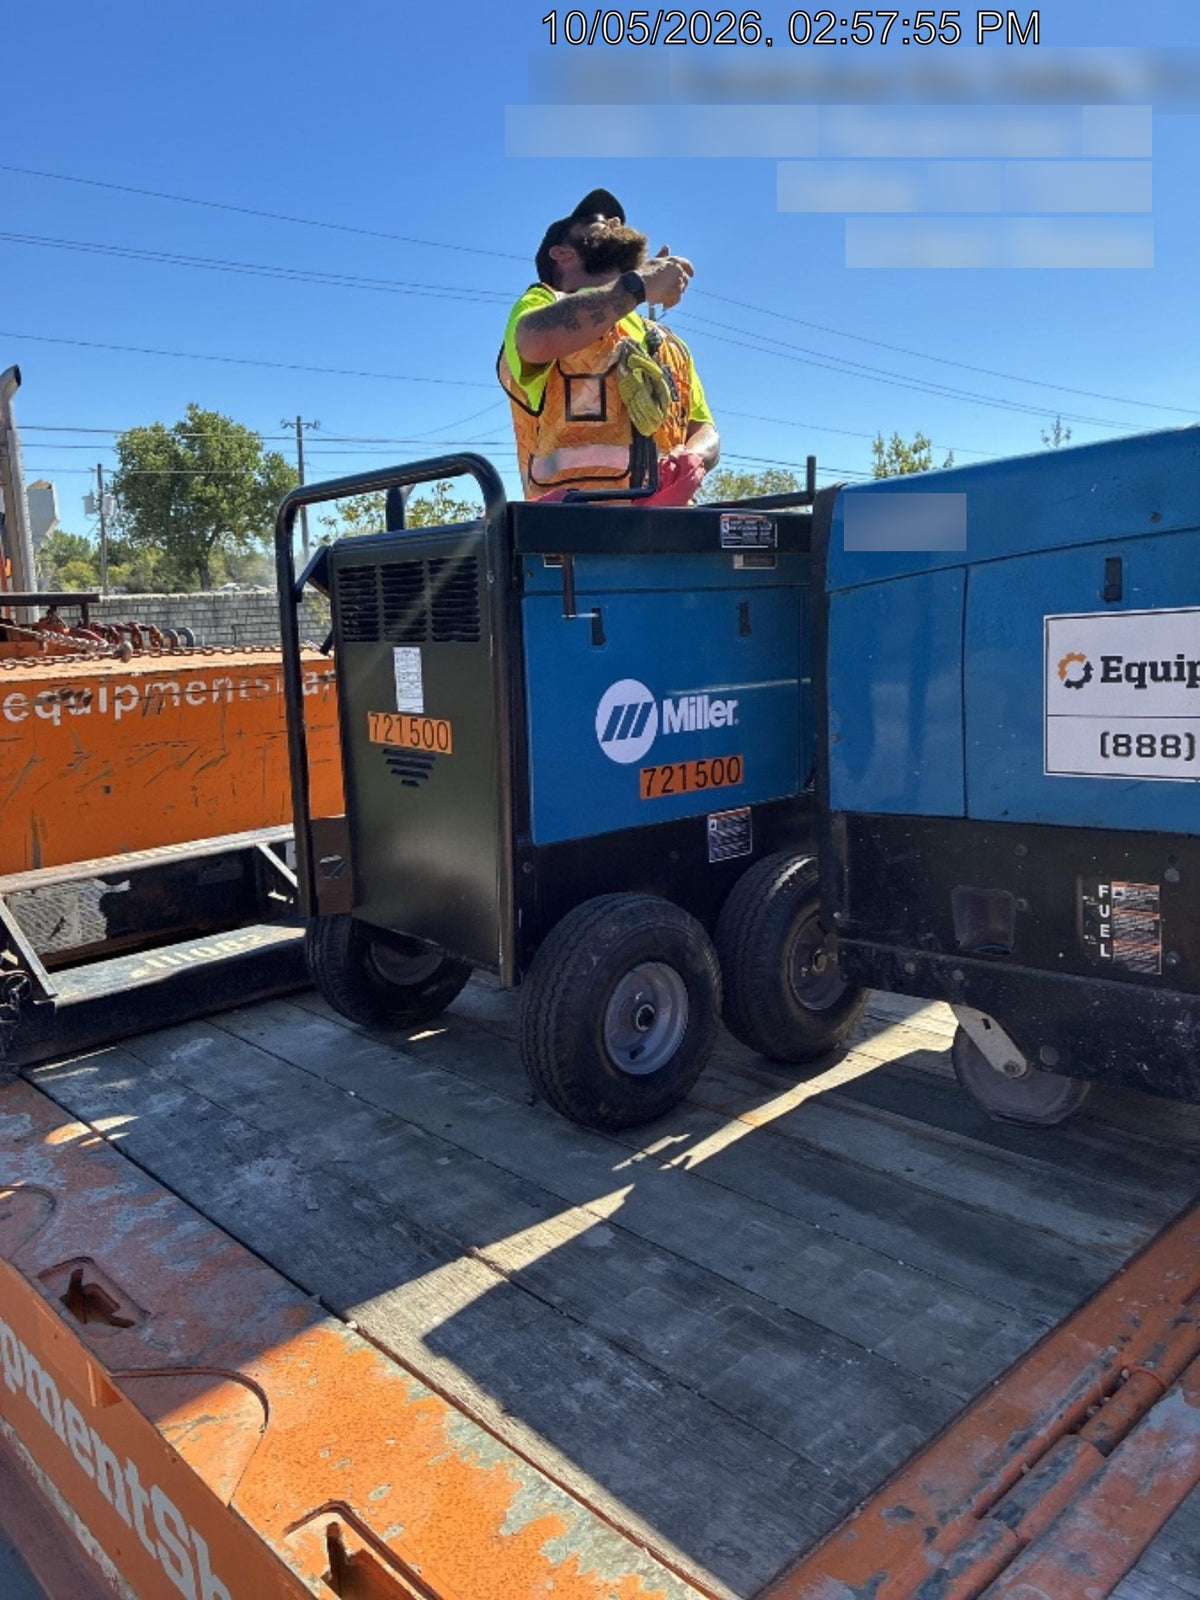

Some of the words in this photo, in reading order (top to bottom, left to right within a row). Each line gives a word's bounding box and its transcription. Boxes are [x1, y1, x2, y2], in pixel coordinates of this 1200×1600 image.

[369, 712, 449, 751] 721500
[662, 694, 740, 735] Miller
[1100, 731, 1196, 761] (888)
[643, 756, 741, 797] 721500
